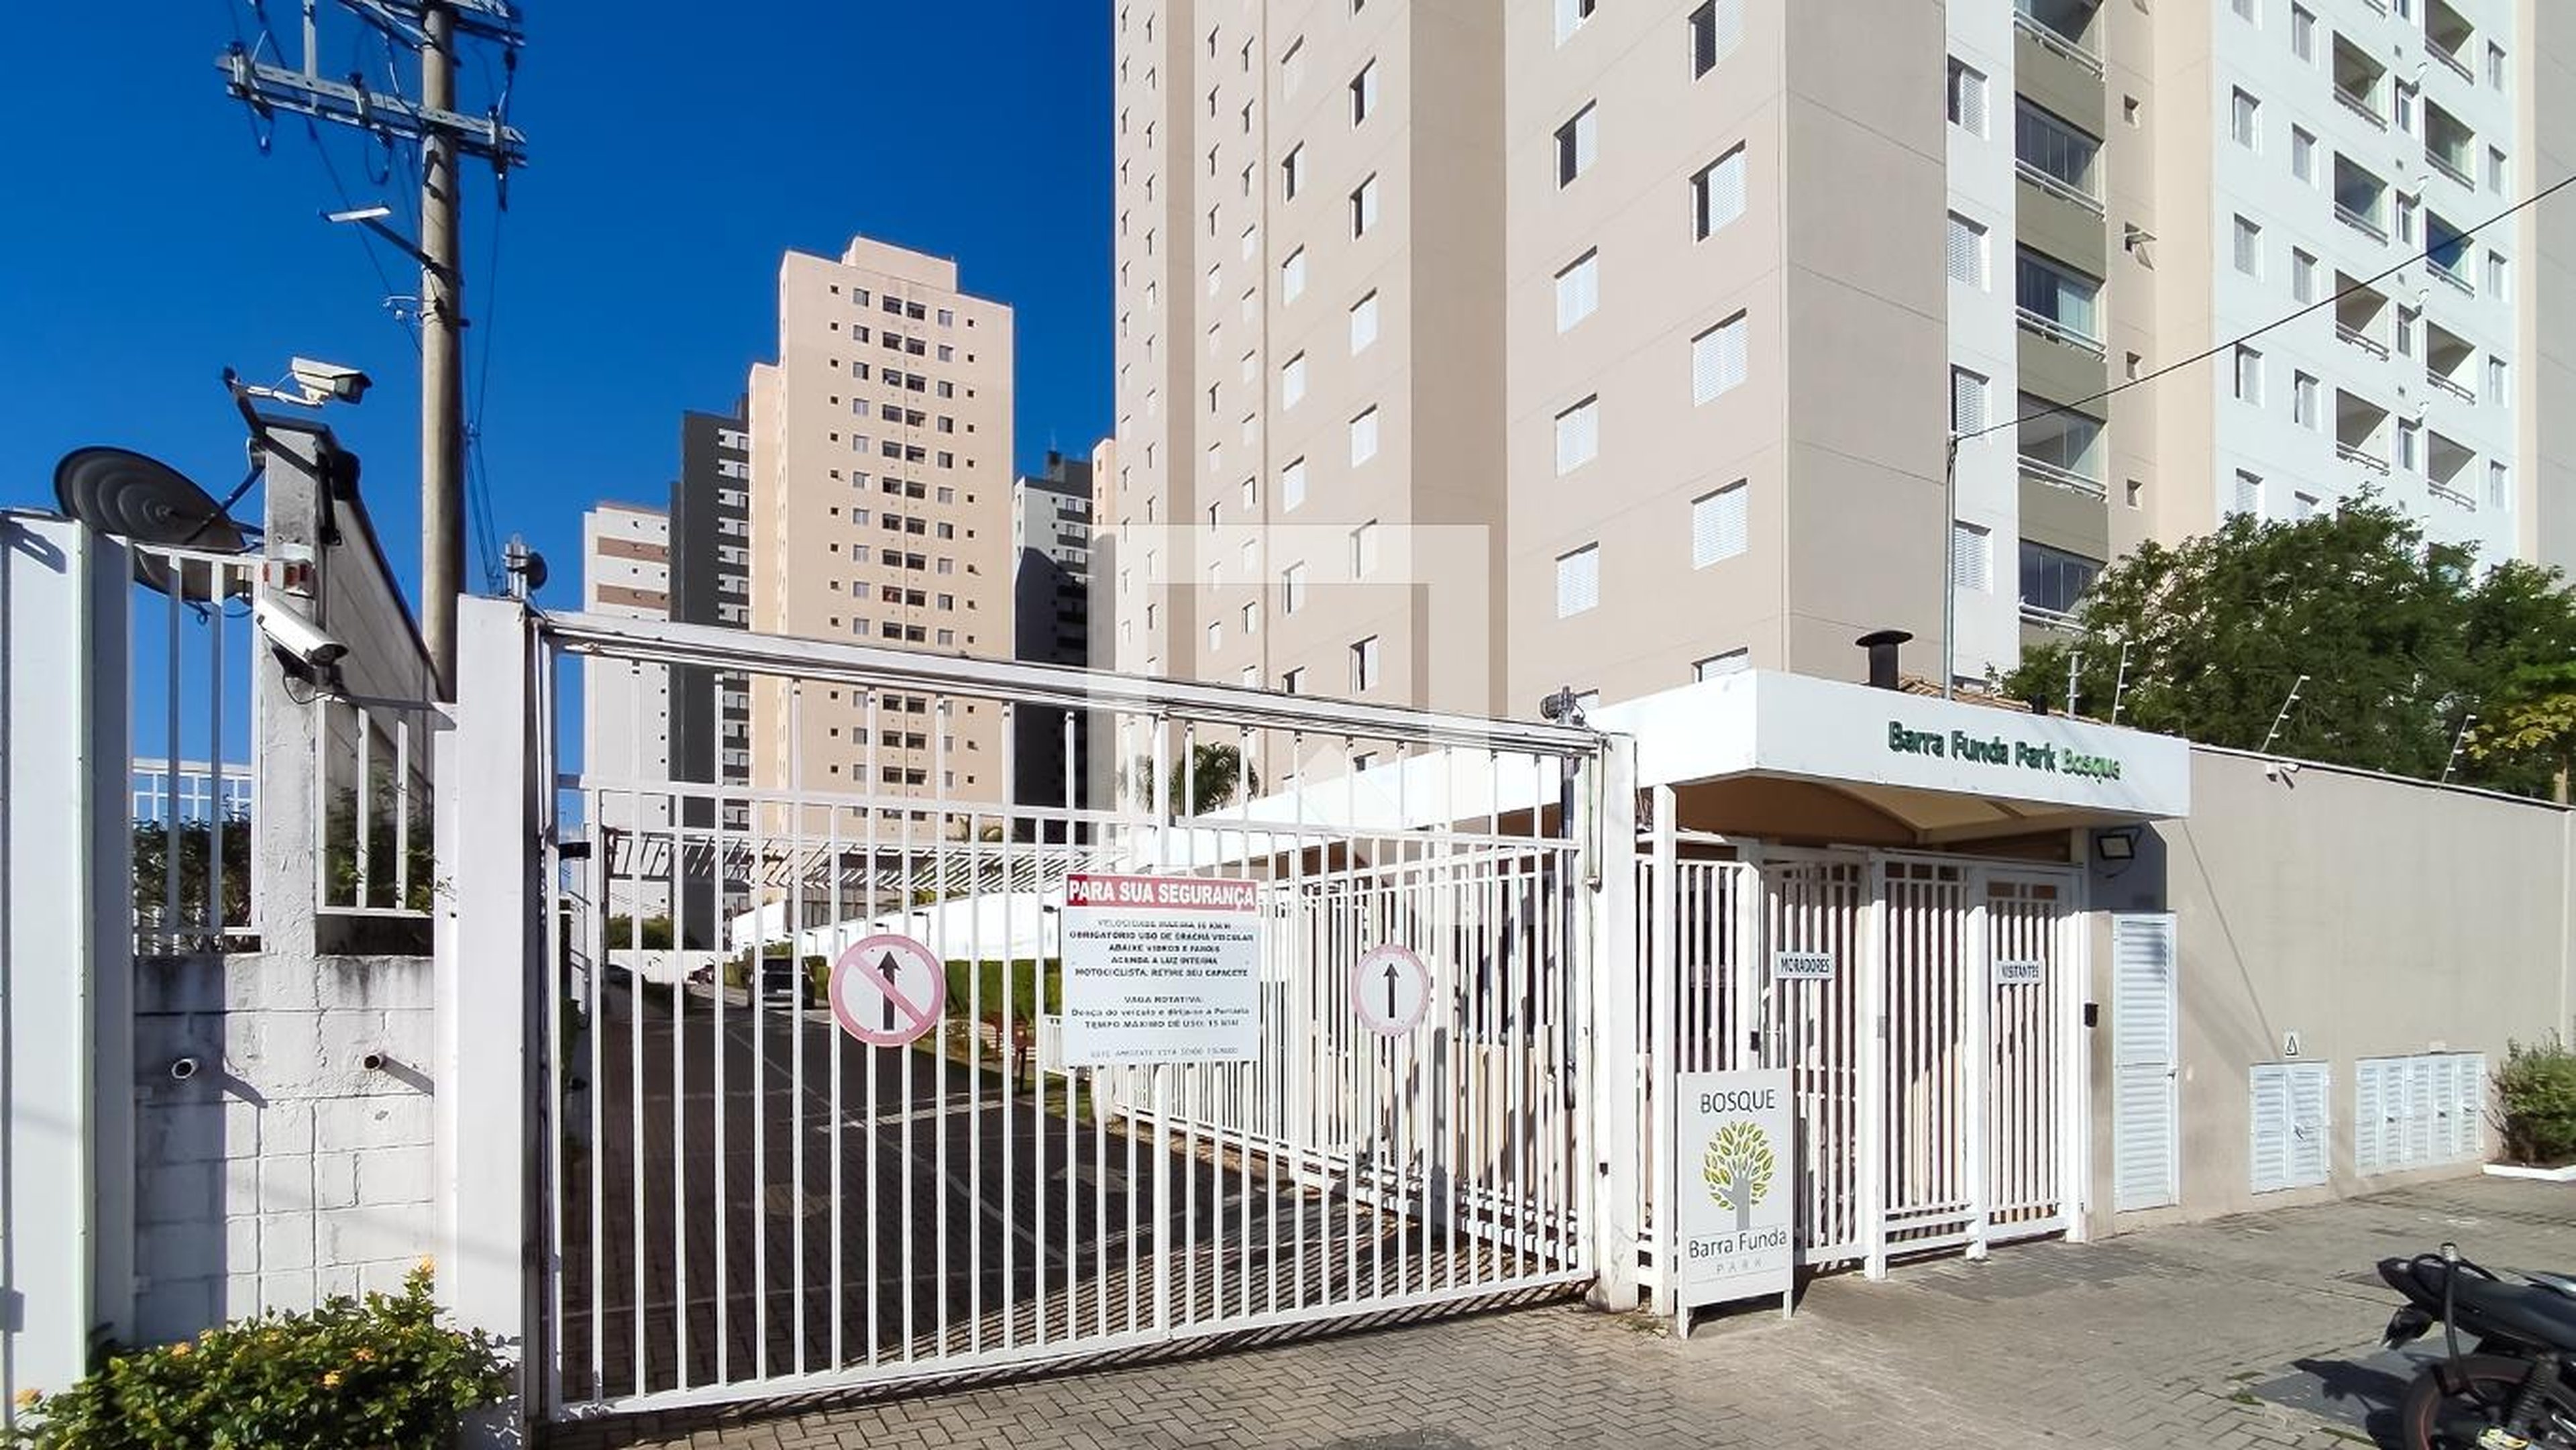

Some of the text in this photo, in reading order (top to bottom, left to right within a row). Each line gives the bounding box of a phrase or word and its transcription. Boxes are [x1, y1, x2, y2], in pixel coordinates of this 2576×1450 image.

[1888, 720, 2121, 784] Barra Funda Park Bosque
[1069, 879, 1255, 907] PARA SUA SEGURANÇA
[1138, 931, 1158, 940] USO
[1160, 932, 1173, 940] DE
[1108, 943, 1143, 951] ABAIXE
[1160, 957, 1178, 965] LUZ
[1780, 957, 1830, 974] MORADORES
[1186, 969, 1203, 977] SEU
[1205, 969, 1248, 977] CAPACETE
[1124, 996, 1152, 1004] VAGA
[1167, 1020, 1181, 1028] DE
[1701, 1089, 1775, 1115] BOSQUE
[1689, 1228, 1787, 1259] Barra Funda
[1716, 1257, 1762, 1275] PARK
